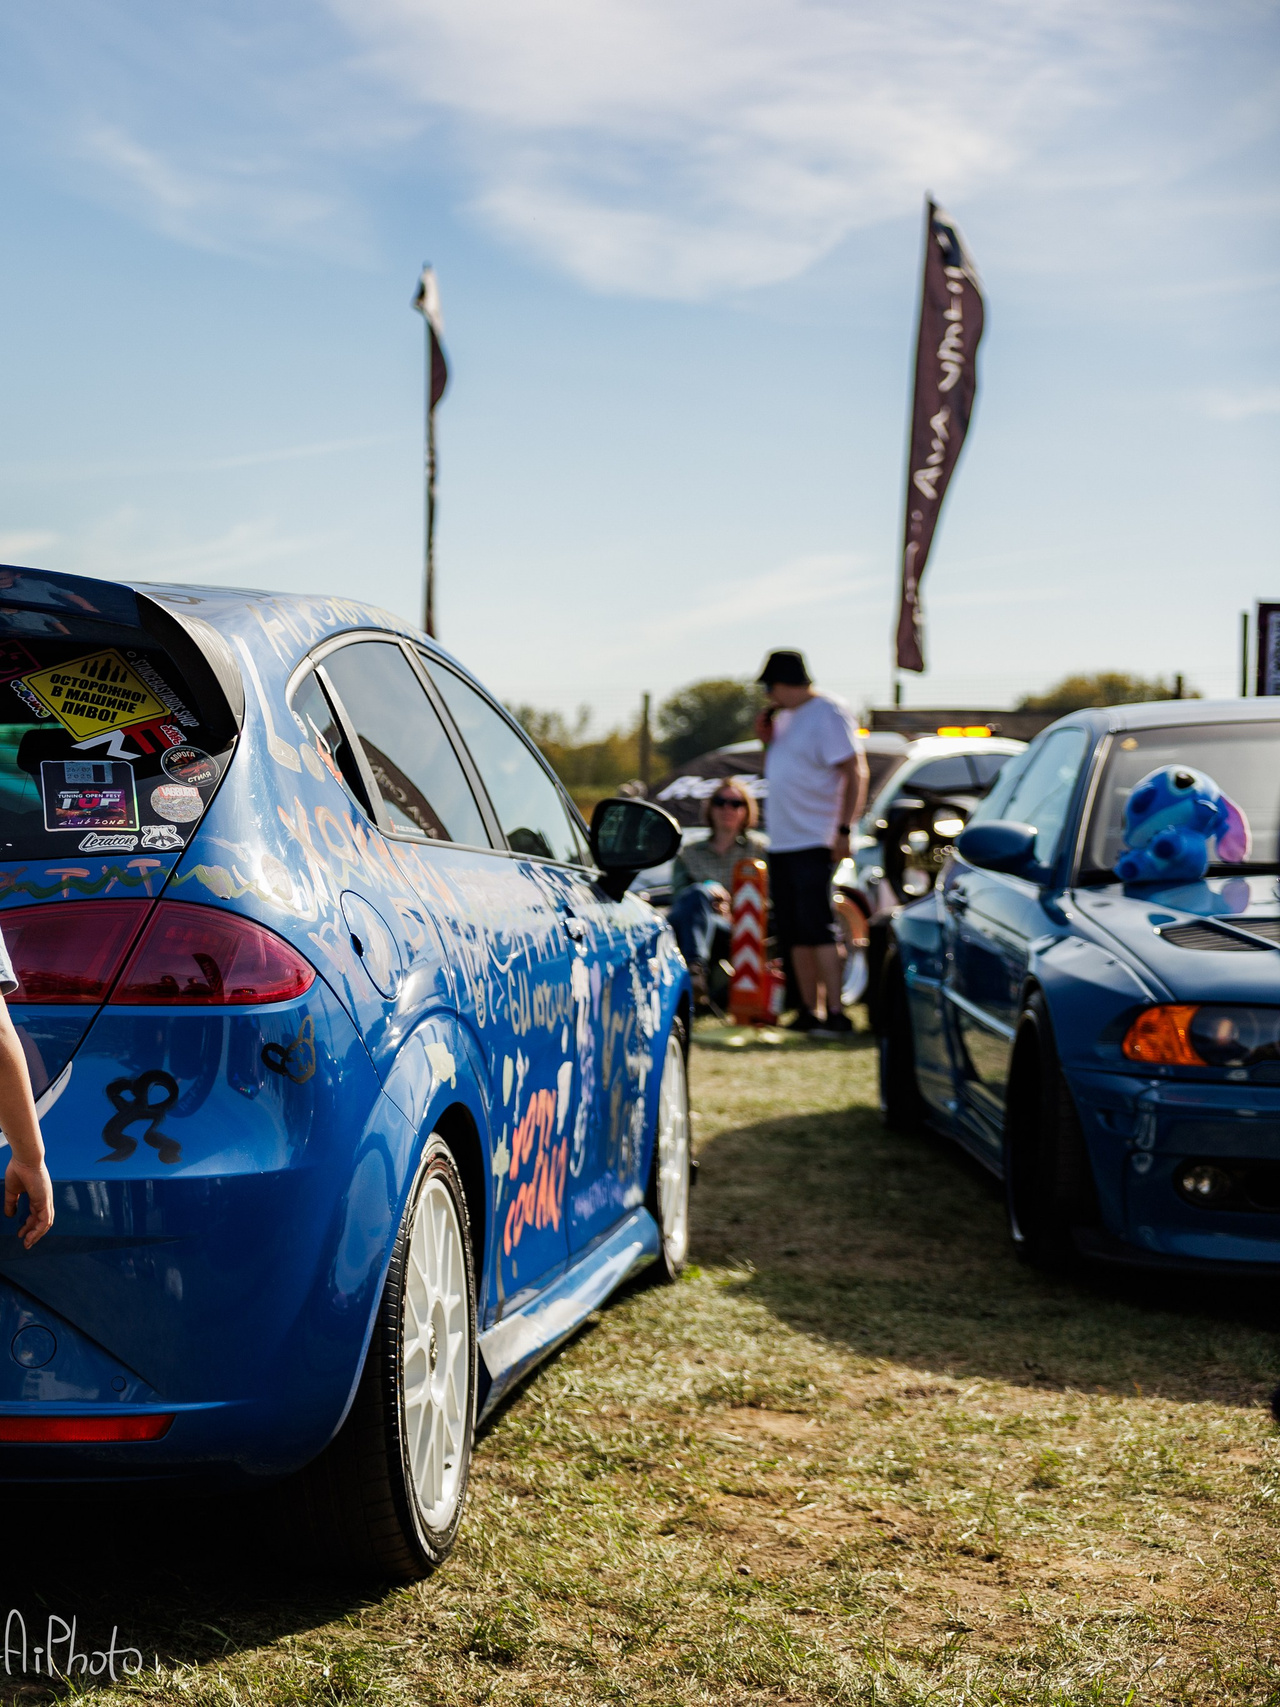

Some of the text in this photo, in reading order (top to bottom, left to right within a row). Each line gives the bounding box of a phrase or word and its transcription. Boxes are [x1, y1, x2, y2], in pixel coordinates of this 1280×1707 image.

[49, 673, 147, 705] ОСТОРОЖНО!
[51, 685, 63, 697] В
[65, 688, 138, 714] МАШИНЕ
[61, 701, 118, 723] ПИВО!
